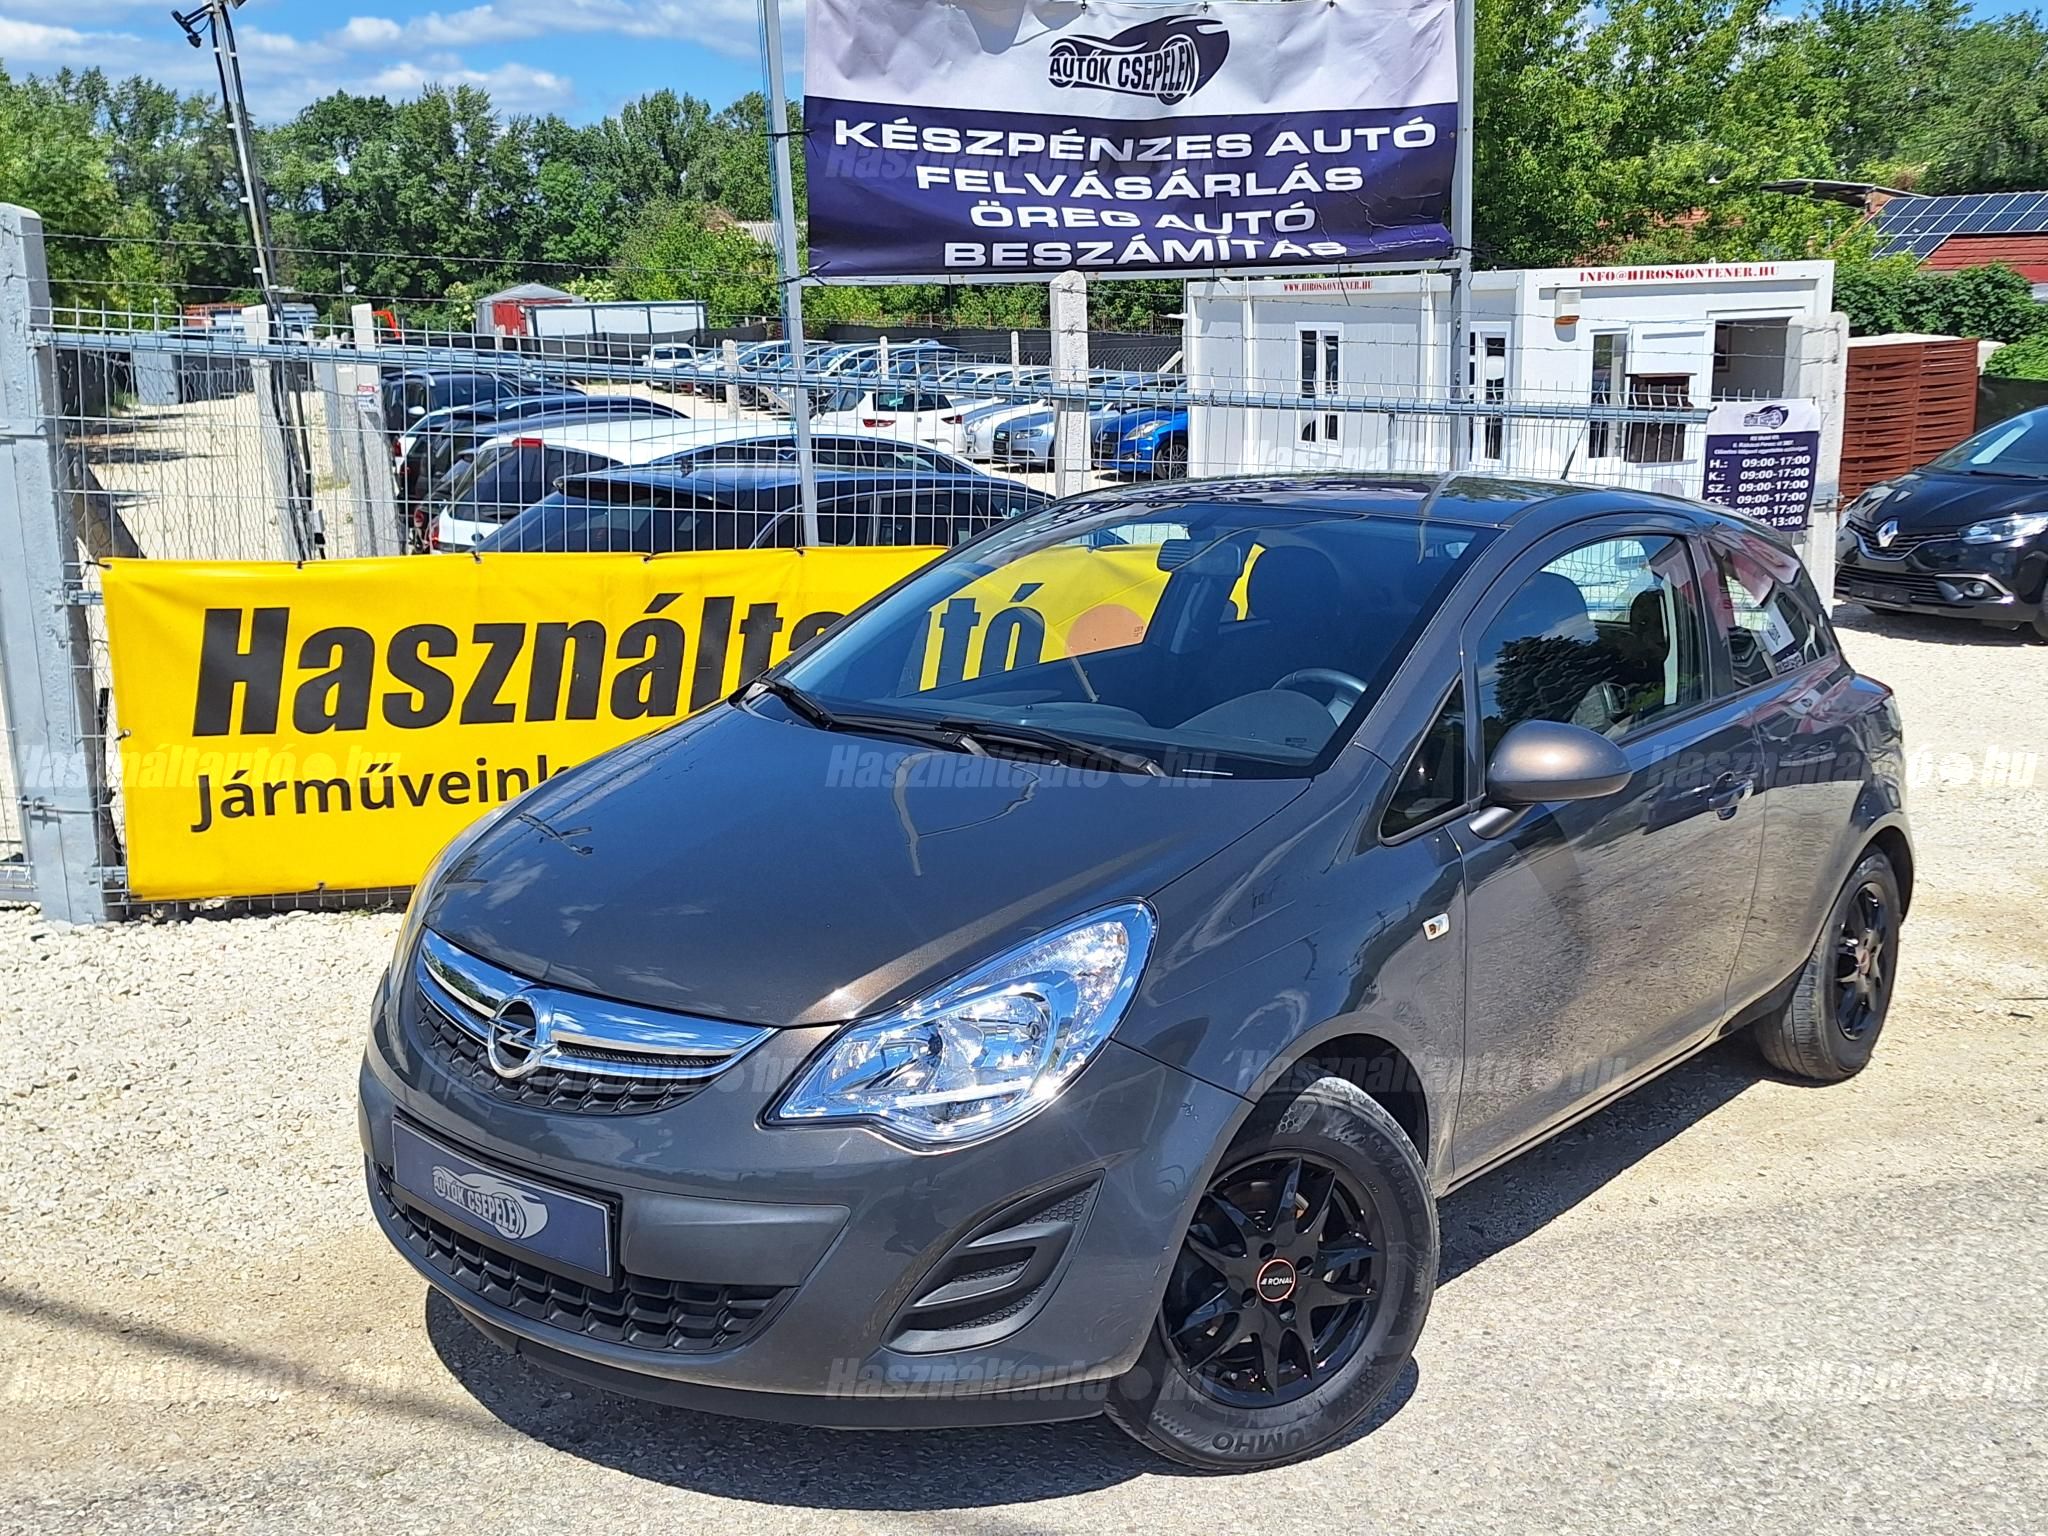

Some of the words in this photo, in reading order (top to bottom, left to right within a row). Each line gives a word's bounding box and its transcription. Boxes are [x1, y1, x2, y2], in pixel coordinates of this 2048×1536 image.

[1050, 50, 1112, 86] AUTÓK
[1117, 41, 1196, 92] CSEPELEN
[835, 117, 1252, 162] KÉSZPÉNZES
[1264, 116, 1437, 157] AUTÓ
[915, 162, 1364, 201] FELVÁSÁRLÁS
[970, 200, 1142, 229] ÖREG
[1154, 200, 1317, 236] AUTÓ
[944, 234, 1348, 268] BESZÁMÍTÁS
[1579, 266, 1780, 283] INFO@HIROSKONTENER.HU
[1740, 467, 1810, 480] 09:00-17:00
[1742, 455, 1811, 468] 09:00-17:00
[1736, 492, 1807, 505] 09:00-17:00
[1738, 480, 1809, 493] 09:00-17:00
[433, 1175, 466, 1207] AUTÓK
[1267, 1276, 1293, 1286] RONAL
[1211, 1427, 1318, 1454] UMHO
